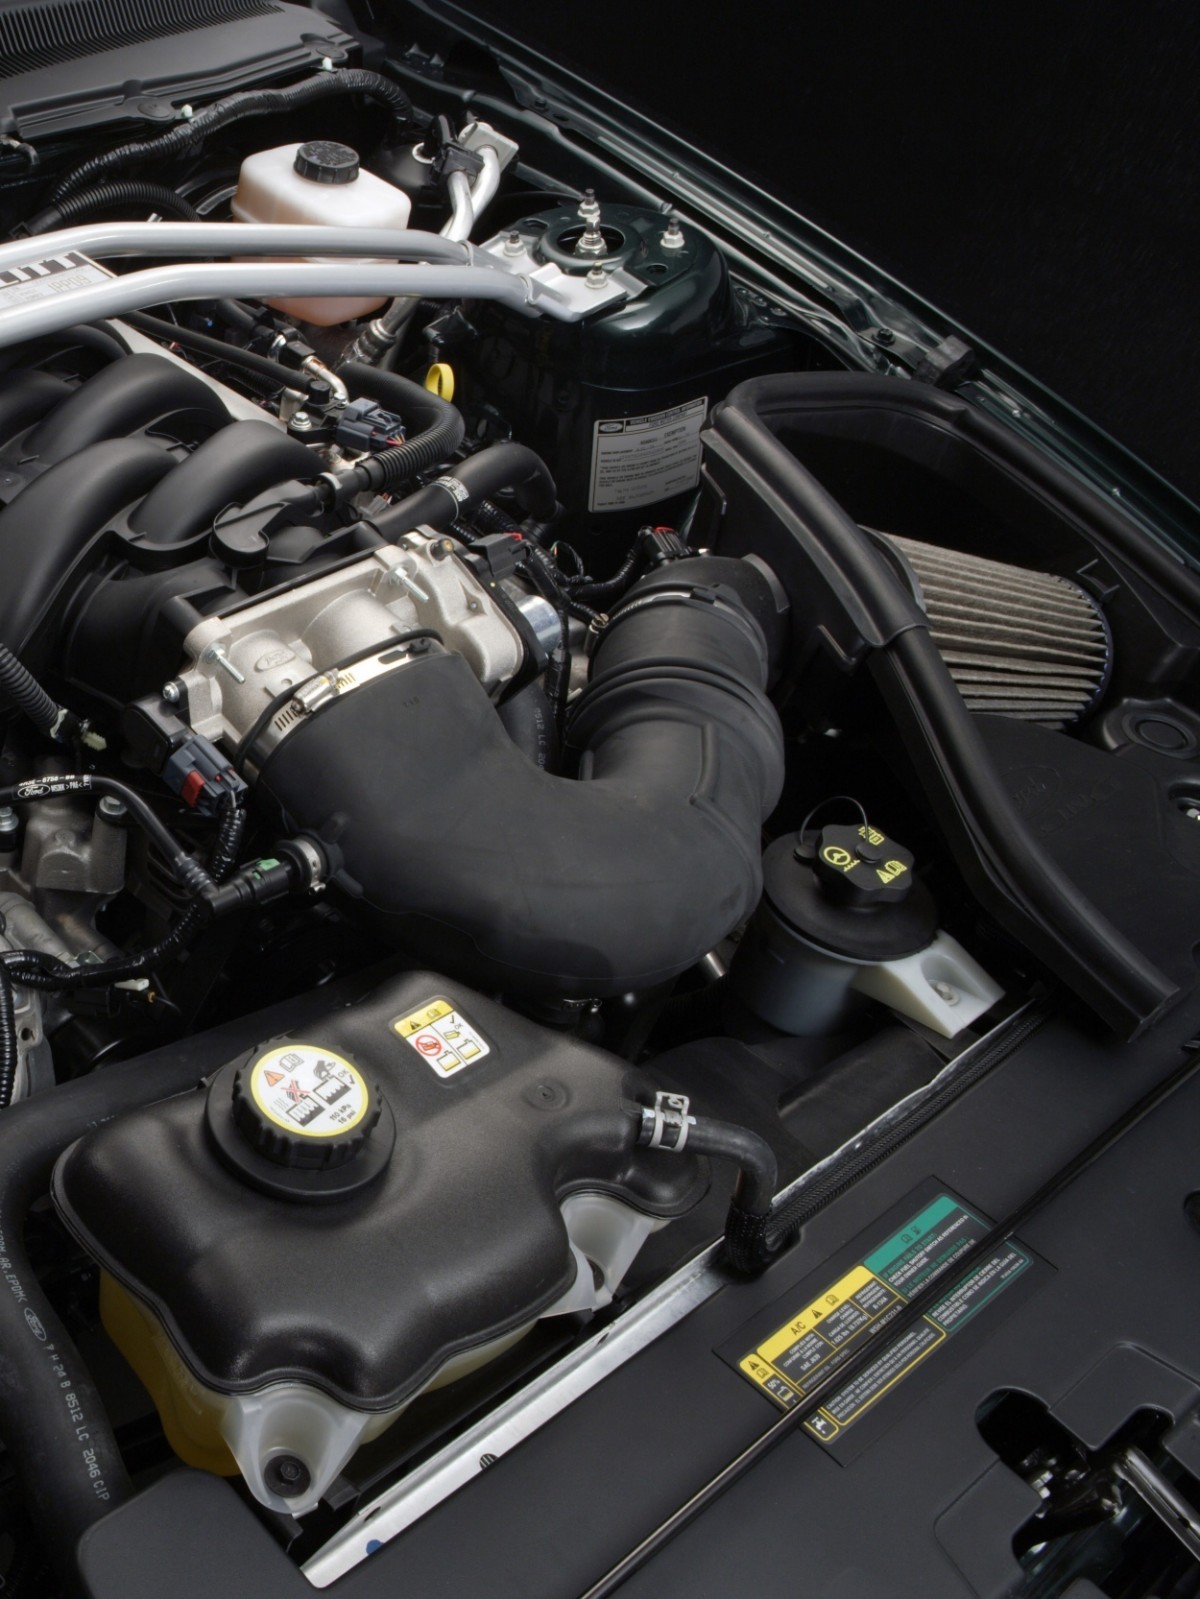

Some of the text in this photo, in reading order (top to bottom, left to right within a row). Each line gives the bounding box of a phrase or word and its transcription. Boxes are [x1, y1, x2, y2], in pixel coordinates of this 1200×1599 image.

[338, 1069, 349, 1078] OK
[330, 1111, 338, 1120] 110
[790, 1320, 807, 1336] A/C
[767, 1377, 781, 1390] 50%
[65, 1391, 84, 1422] 8512
[75, 1426, 90, 1442] LC
[82, 1447, 101, 1479] 2046
